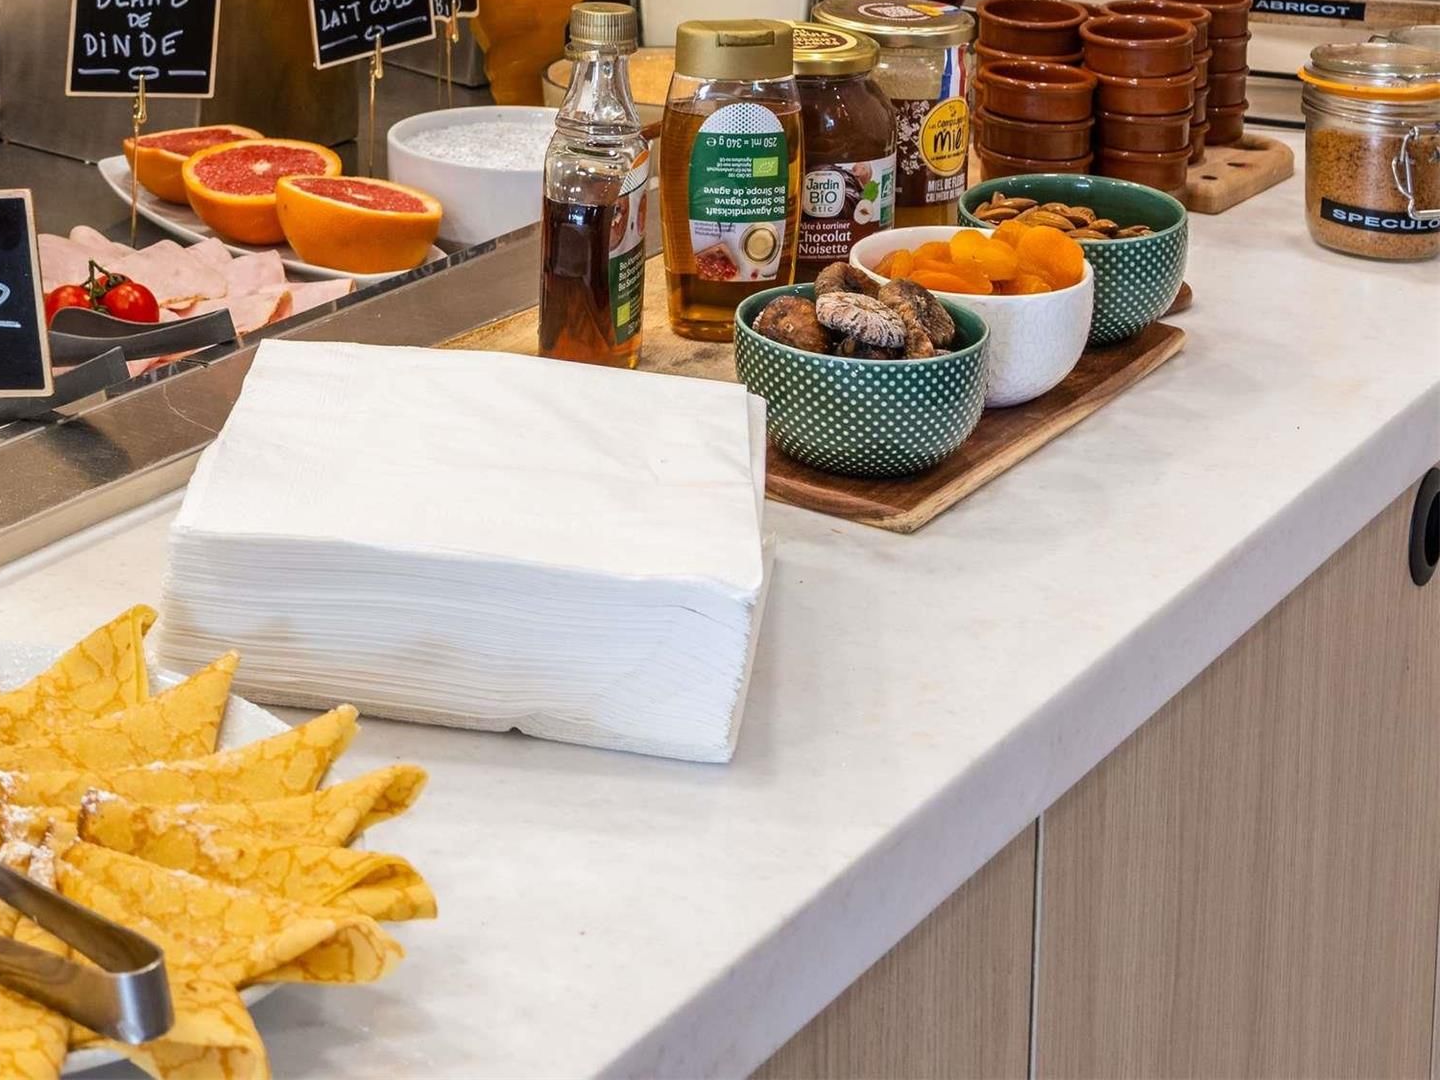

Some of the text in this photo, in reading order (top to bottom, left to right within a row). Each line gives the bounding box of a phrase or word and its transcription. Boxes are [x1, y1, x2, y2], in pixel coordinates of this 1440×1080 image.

[1255, 0, 1351, 16] ABRICOT
[127, 11, 153, 28] DE
[763, 137, 778, 148] 250
[806, 178, 840, 191] Jardin
[703, 186, 786, 196] Bio Sirope de agave
[714, 196, 785, 207] Bio Sirop d'agave
[705, 206, 785, 217] Bio Agavendicksaft
[798, 243, 849, 255] Noisette
